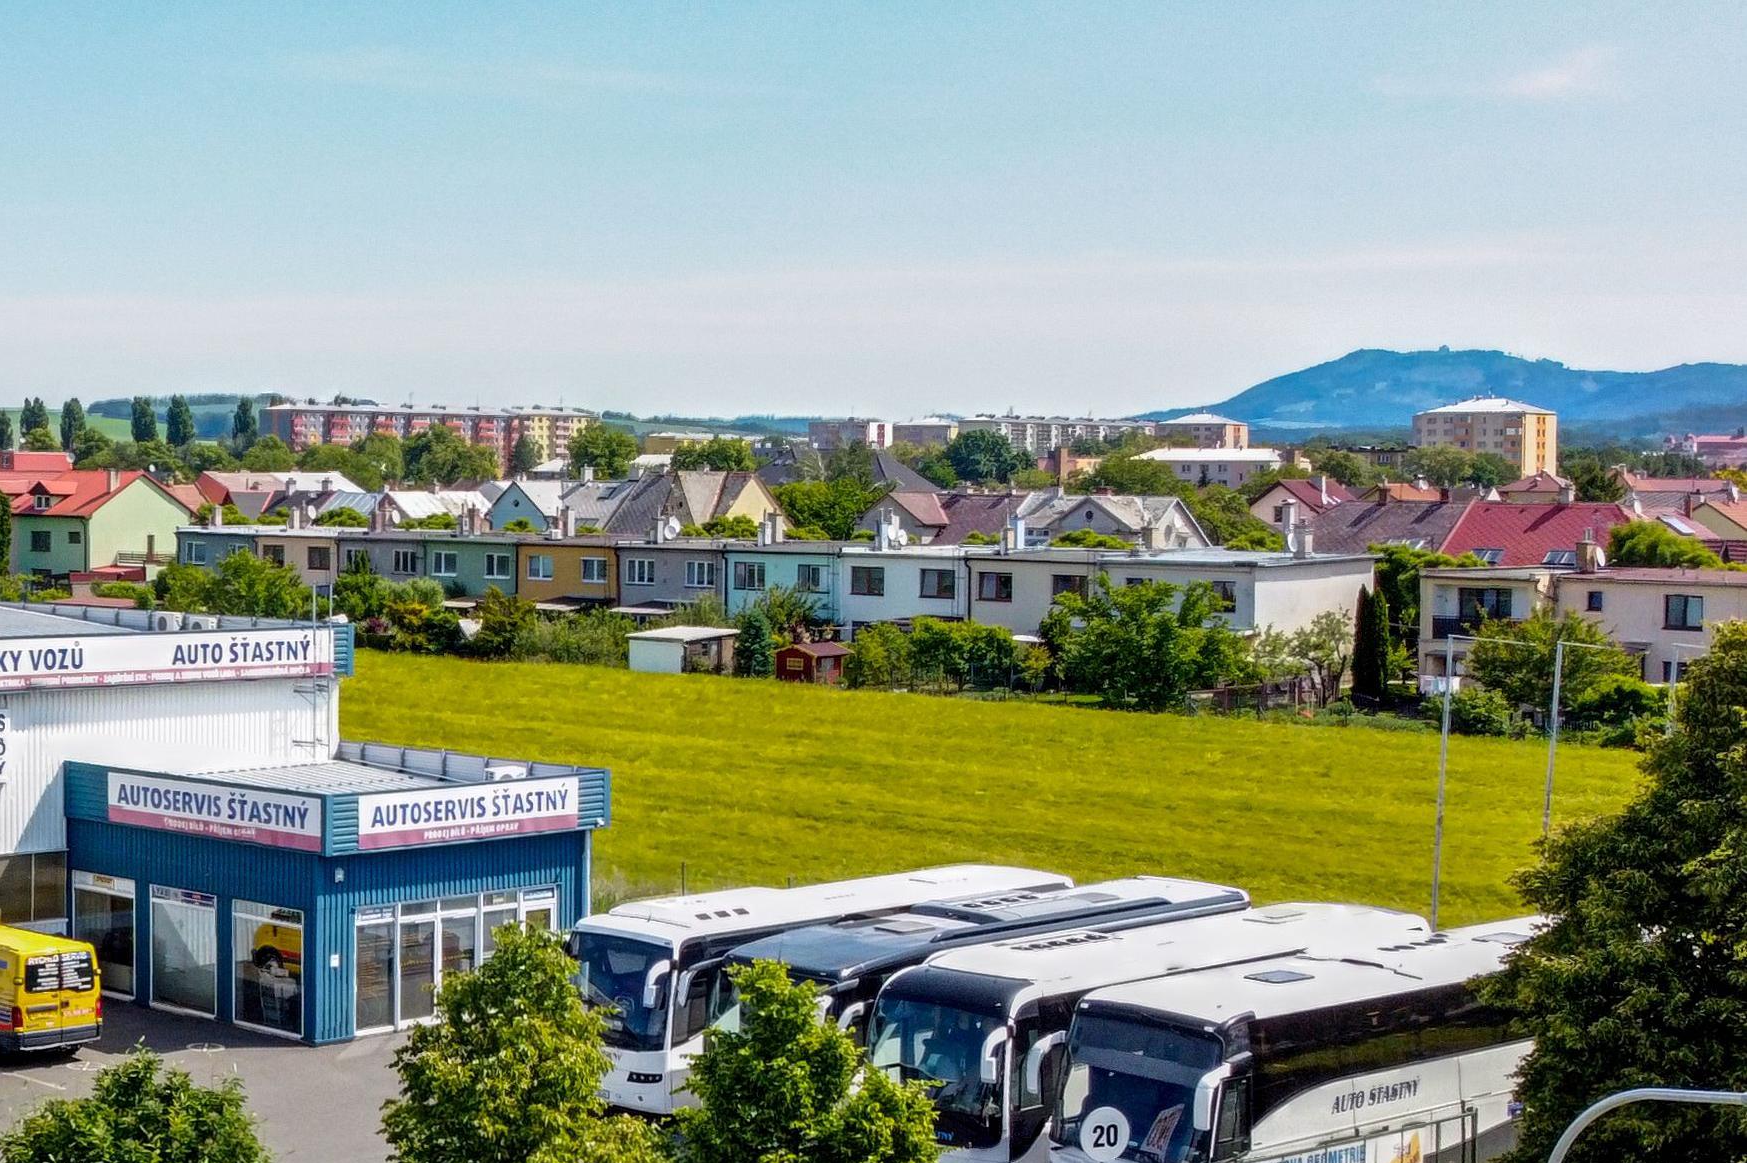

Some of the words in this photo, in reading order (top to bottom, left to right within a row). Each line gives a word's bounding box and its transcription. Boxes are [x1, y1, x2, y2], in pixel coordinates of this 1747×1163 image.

[29, 641, 83, 670] VOZŮ
[172, 642, 223, 665] AUTO
[229, 634, 311, 663] ŠŤASTNÝ
[118, 783, 221, 817] AUTOSERVIS
[227, 792, 309, 829] ŠŤASTNÝ
[371, 796, 486, 828] AUTOSERVIS
[492, 782, 568, 817] ŠŤASTNÝ
[1332, 1091, 1365, 1114] AUTO
[1093, 1124, 1118, 1148] 20
